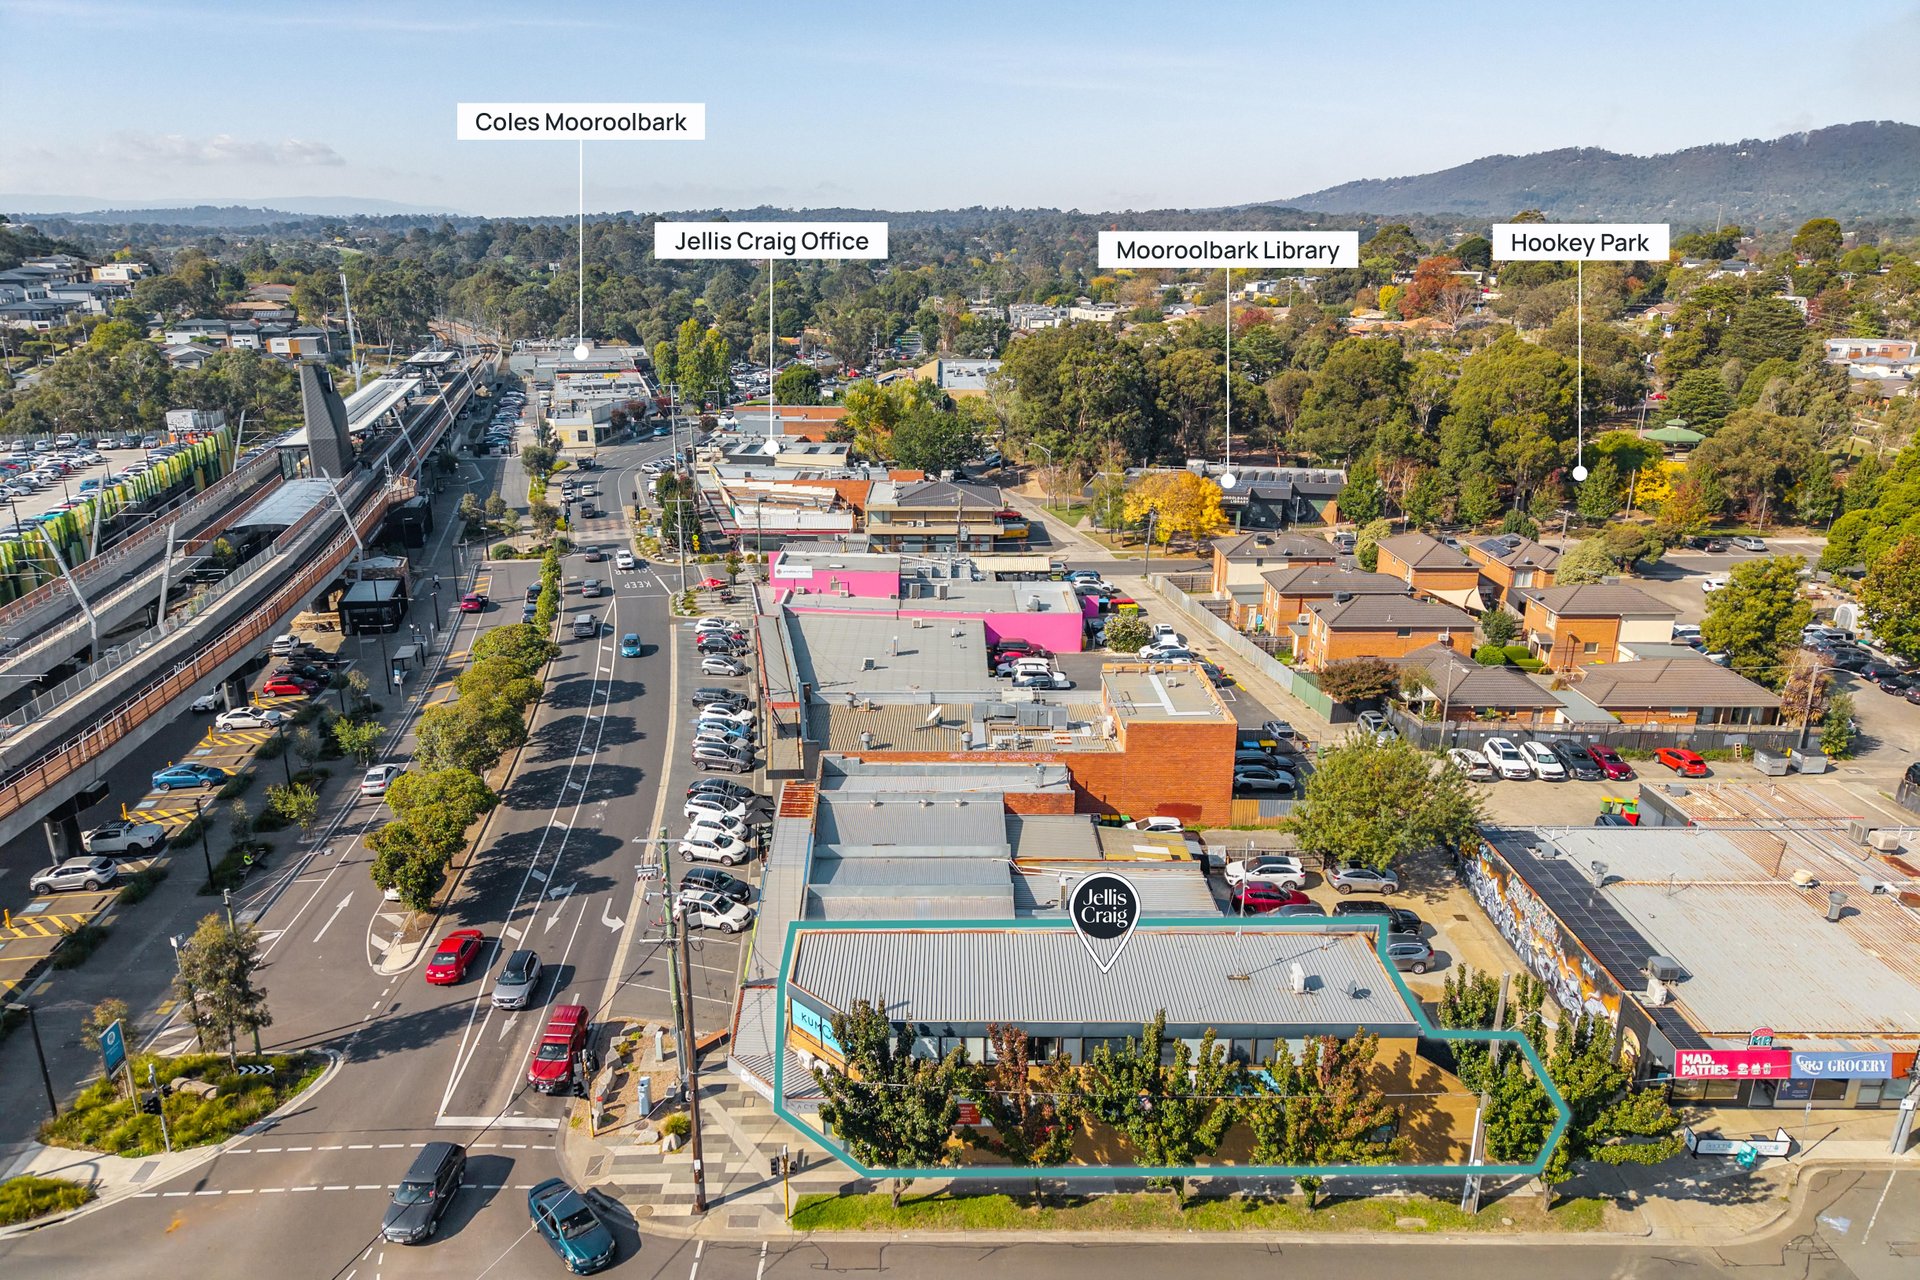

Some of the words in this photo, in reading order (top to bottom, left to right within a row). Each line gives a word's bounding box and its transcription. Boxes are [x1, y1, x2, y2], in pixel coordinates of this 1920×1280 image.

[624, 580, 652, 589] KEEP
[801, 1012, 836, 1042] KUMO
[1681, 1053, 1715, 1065] MAD.
[1681, 1064, 1729, 1076] PATTIES
[1827, 1059, 1888, 1073] GROCERY
